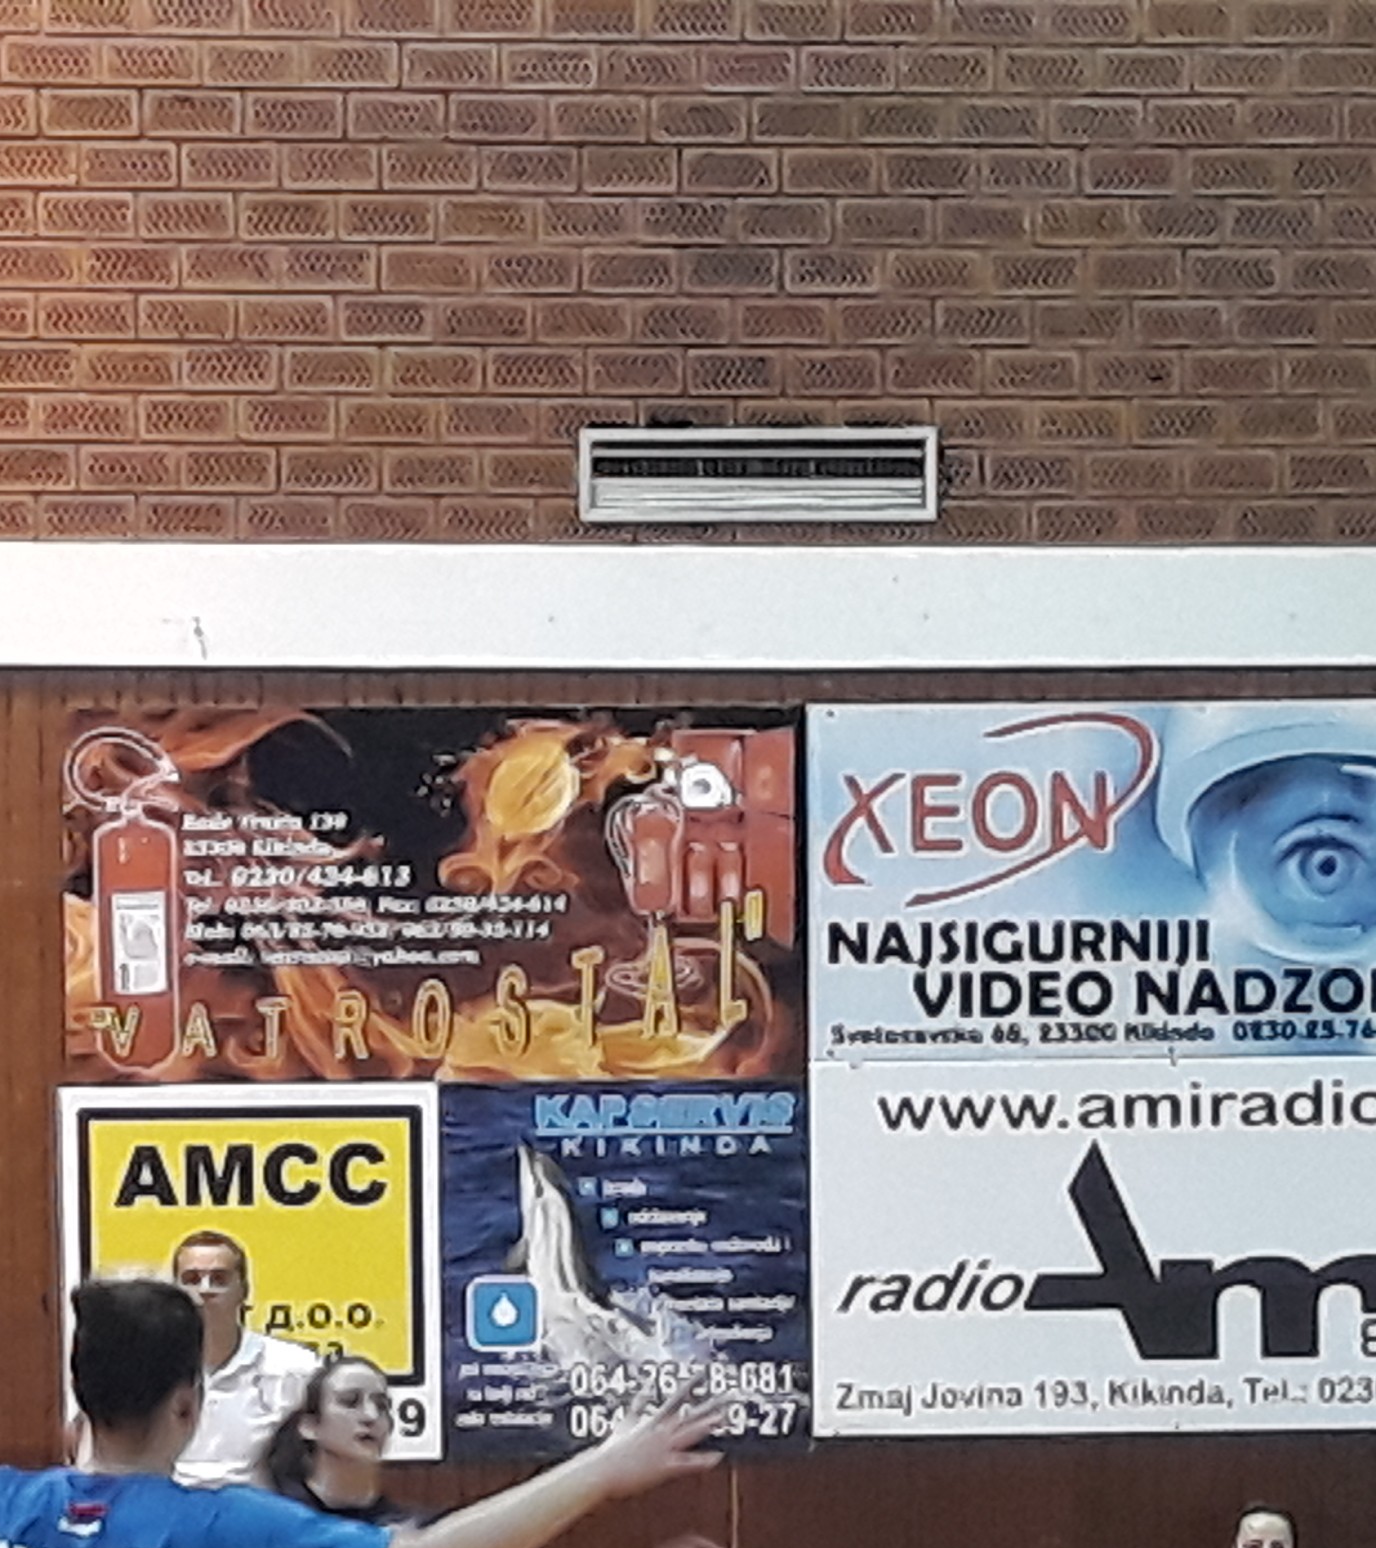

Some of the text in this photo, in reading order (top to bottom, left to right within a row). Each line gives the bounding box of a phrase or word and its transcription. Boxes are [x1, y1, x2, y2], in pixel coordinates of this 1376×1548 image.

[824, 771, 1112, 886] XEON
[827, 919, 1211, 968] NAJSIGURNIJI
[102, 893, 747, 1060] VATROSTAL
[913, 969, 1112, 1018] VIDEO
[560, 1135, 773, 1158] KIKINDA
[837, 1259, 1026, 1314] radio
[836, 1380, 912, 1416] Zmaj
[921, 1381, 1023, 1409] Jovina
[1108, 1377, 1234, 1409] Kikinda,
